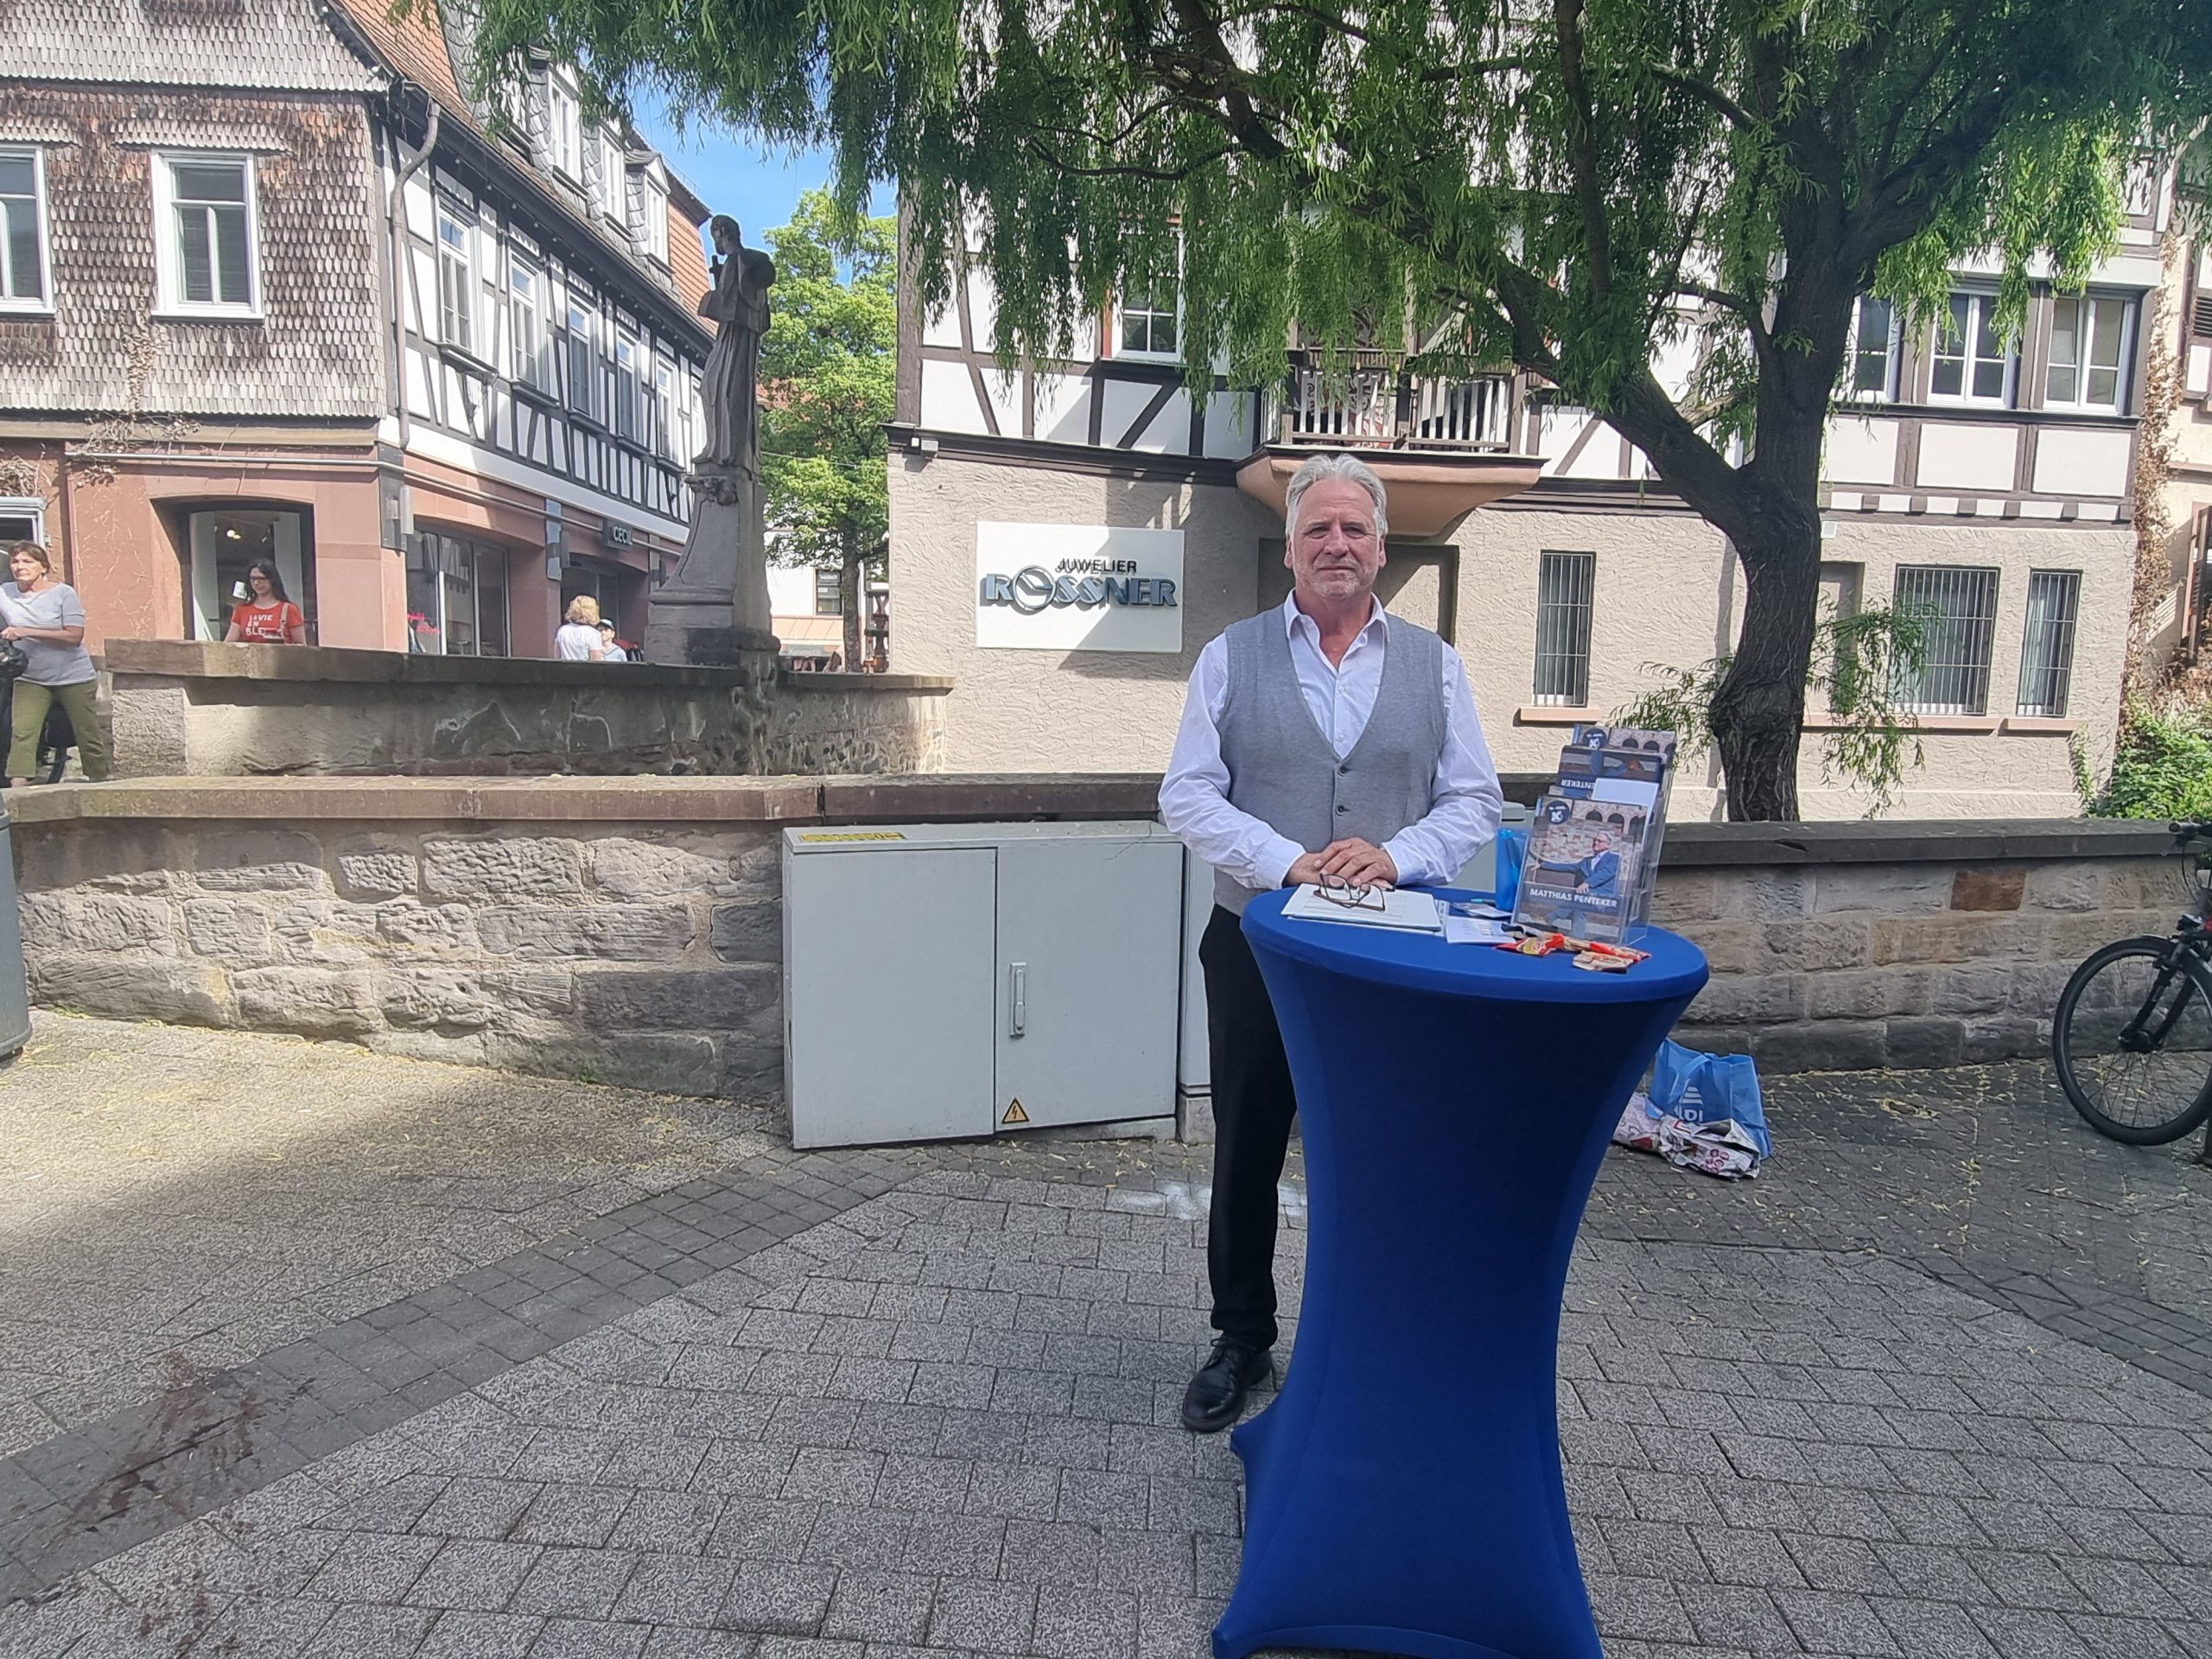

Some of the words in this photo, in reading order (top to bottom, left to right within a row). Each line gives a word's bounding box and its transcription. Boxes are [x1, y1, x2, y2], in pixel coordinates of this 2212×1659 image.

[1057, 557, 1137, 574] JUWELIER
[985, 564, 1178, 610] ROSSNER
[245, 626, 264, 636] BLE
[1560, 779, 1595, 789] ENTEKER
[1529, 887, 1572, 901] MATTHIAS
[1573, 893, 1618, 908] PENTEKER
